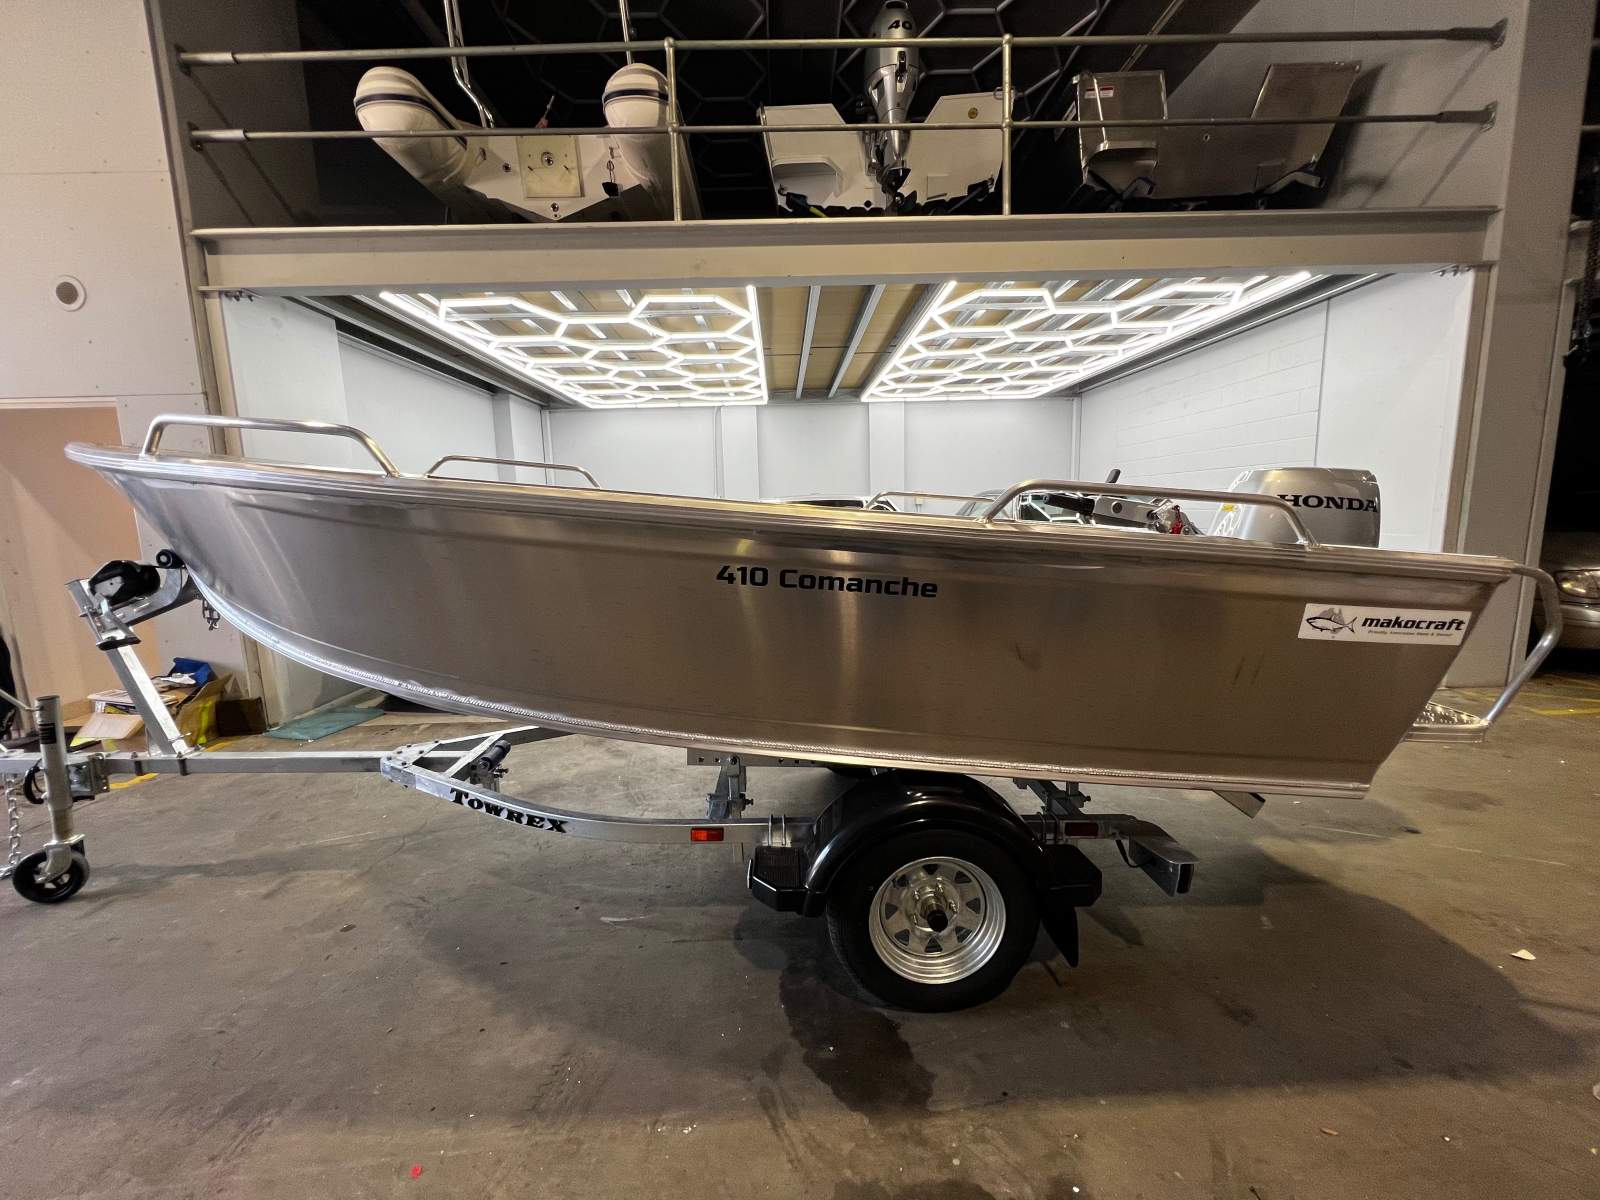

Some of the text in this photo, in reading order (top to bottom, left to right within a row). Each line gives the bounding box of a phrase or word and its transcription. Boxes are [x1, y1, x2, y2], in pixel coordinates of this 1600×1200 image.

[888, 19, 912, 30] 40
[1277, 494, 1378, 512] HONDA
[716, 565, 938, 598] 410 Comanche
[1361, 616, 1466, 631] makocraft
